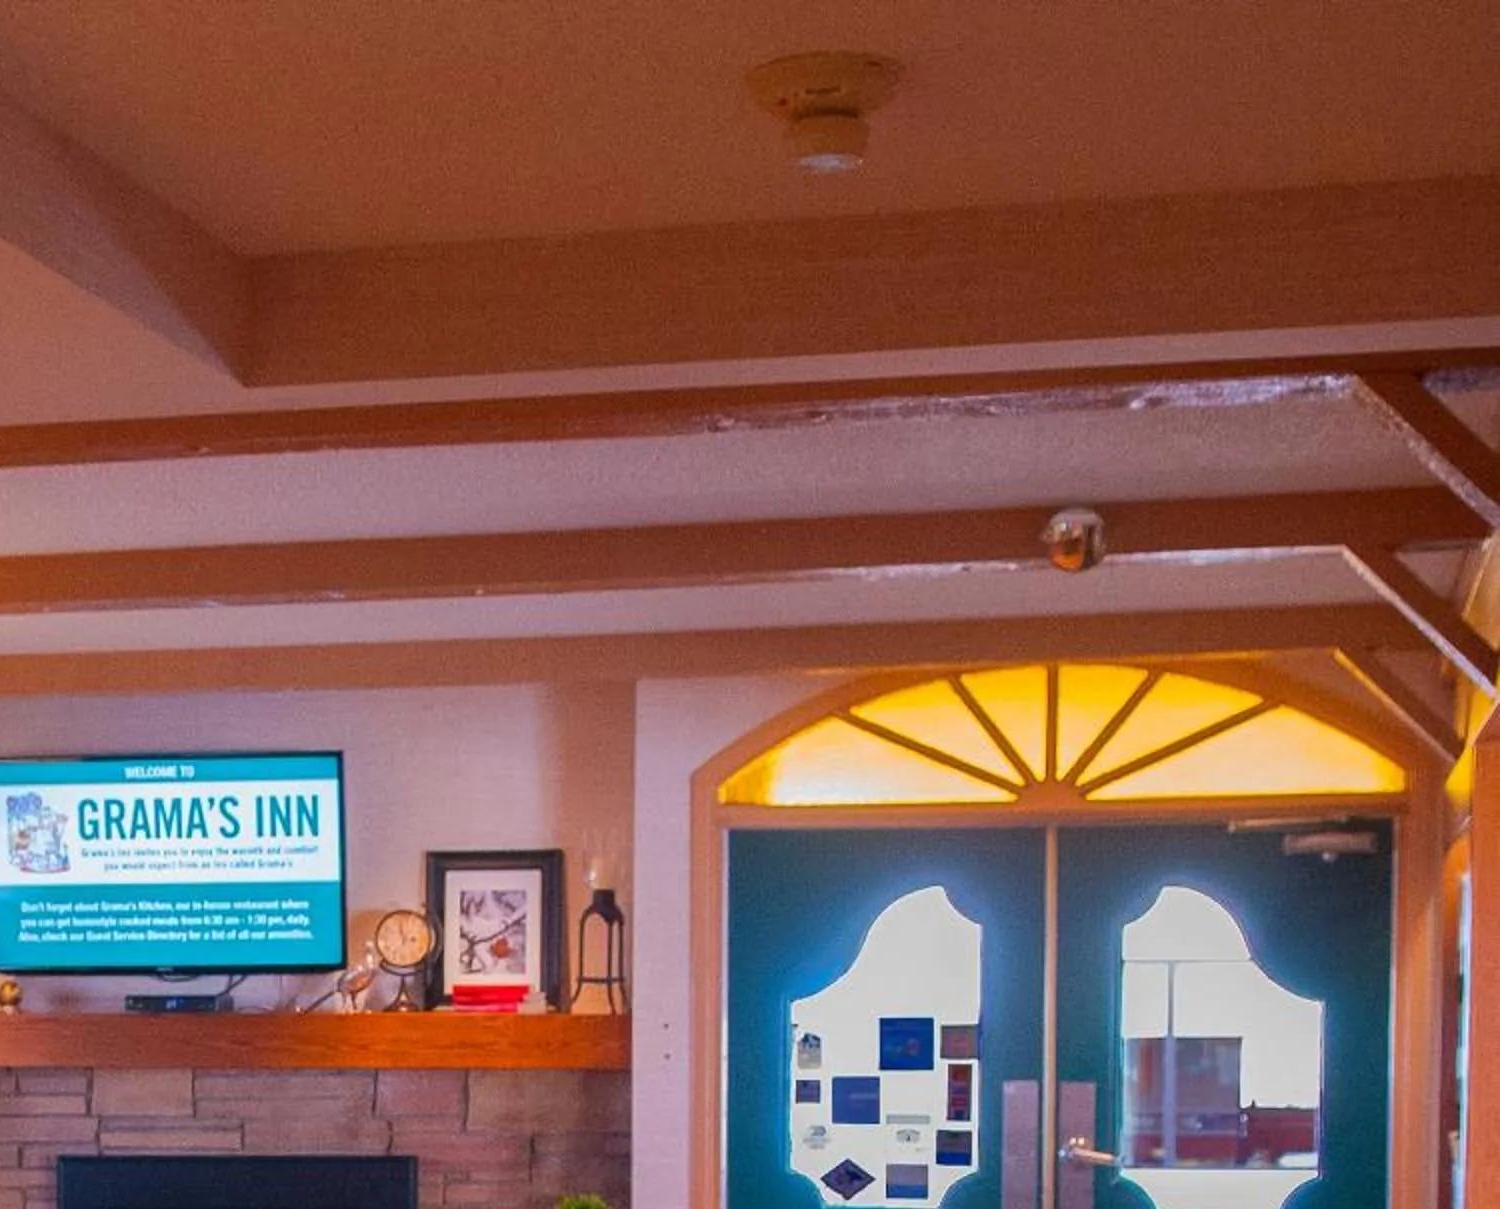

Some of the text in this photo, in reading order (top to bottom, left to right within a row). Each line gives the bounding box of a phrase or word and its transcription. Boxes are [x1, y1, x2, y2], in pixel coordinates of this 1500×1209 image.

[124, 765, 195, 779] WELCOME TO
[77, 794, 320, 840] GRAMA'S INN
[266, 845, 281, 854] and
[20, 901, 45, 912] Don't
[45, 901, 72, 915] forget
[75, 901, 99, 912] about
[101, 900, 137, 912] Grama's
[175, 902, 190, 911] our
[233, 899, 279, 910] restaurant
[281, 898, 309, 910] where
[20, 918, 37, 929] you
[38, 918, 54, 928] can
[56, 917, 71, 929] get
[119, 915, 151, 926] cooked
[152, 915, 179, 926] meals
[180, 915, 202, 926] from
[224, 916, 240, 925] am
[42, 931, 68, 941] check
[69, 932, 84, 941] our
[86, 930, 111, 941] Guest
[113, 930, 145, 941] Service
[147, 929, 187, 943] Directory
[188, 929, 201, 940] for
[211, 929, 225, 940] list
[226, 929, 237, 940] of
[238, 929, 250, 940] all
[251, 930, 267, 940] our
